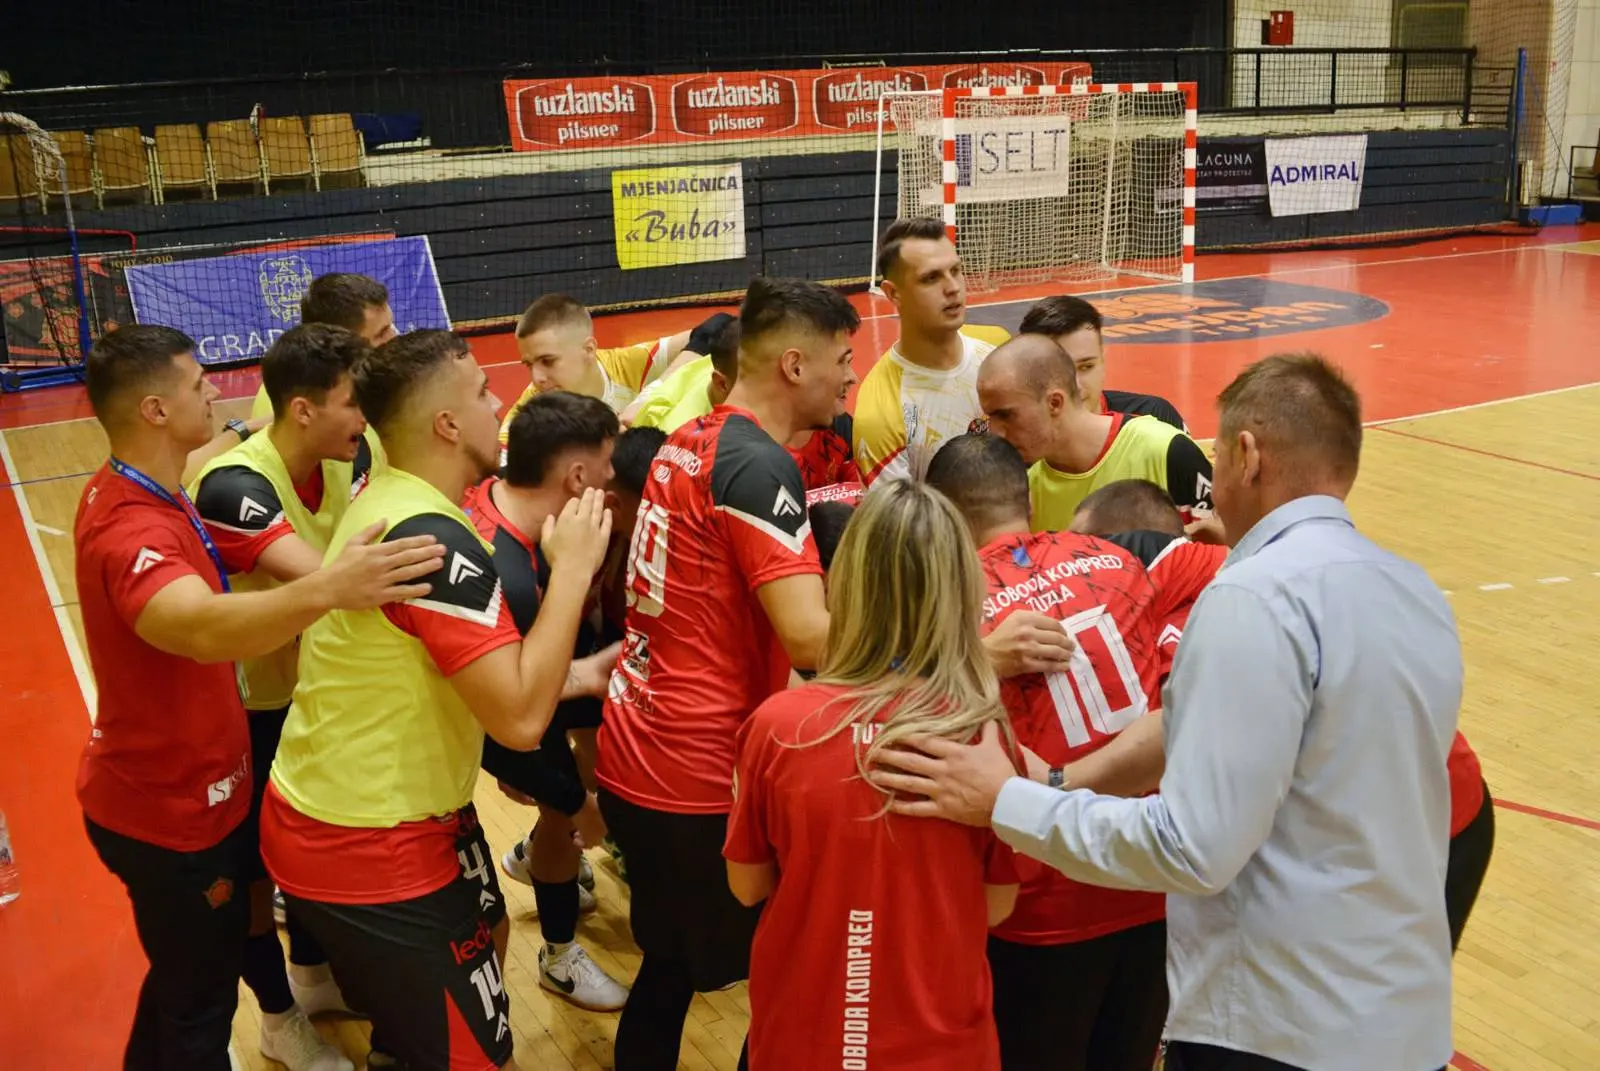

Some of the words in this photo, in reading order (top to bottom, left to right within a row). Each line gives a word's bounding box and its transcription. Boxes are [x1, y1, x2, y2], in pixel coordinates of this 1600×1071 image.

[535, 84, 636, 116] tuzlanski
[688, 77, 781, 108] tuzlanski
[828, 71, 911, 102] tuzlanski
[558, 122, 619, 144] pilsner
[708, 115, 765, 135] pilsner
[621, 174, 738, 198] MJENJAČNICA
[1271, 161, 1358, 186] ADMIRAL
[982, 573, 1052, 618] SLOBODA
[1045, 554, 1123, 582] KOMPRED
[1025, 583, 1076, 613] TUZLA
[845, 910, 873, 1003] KOMPRED
